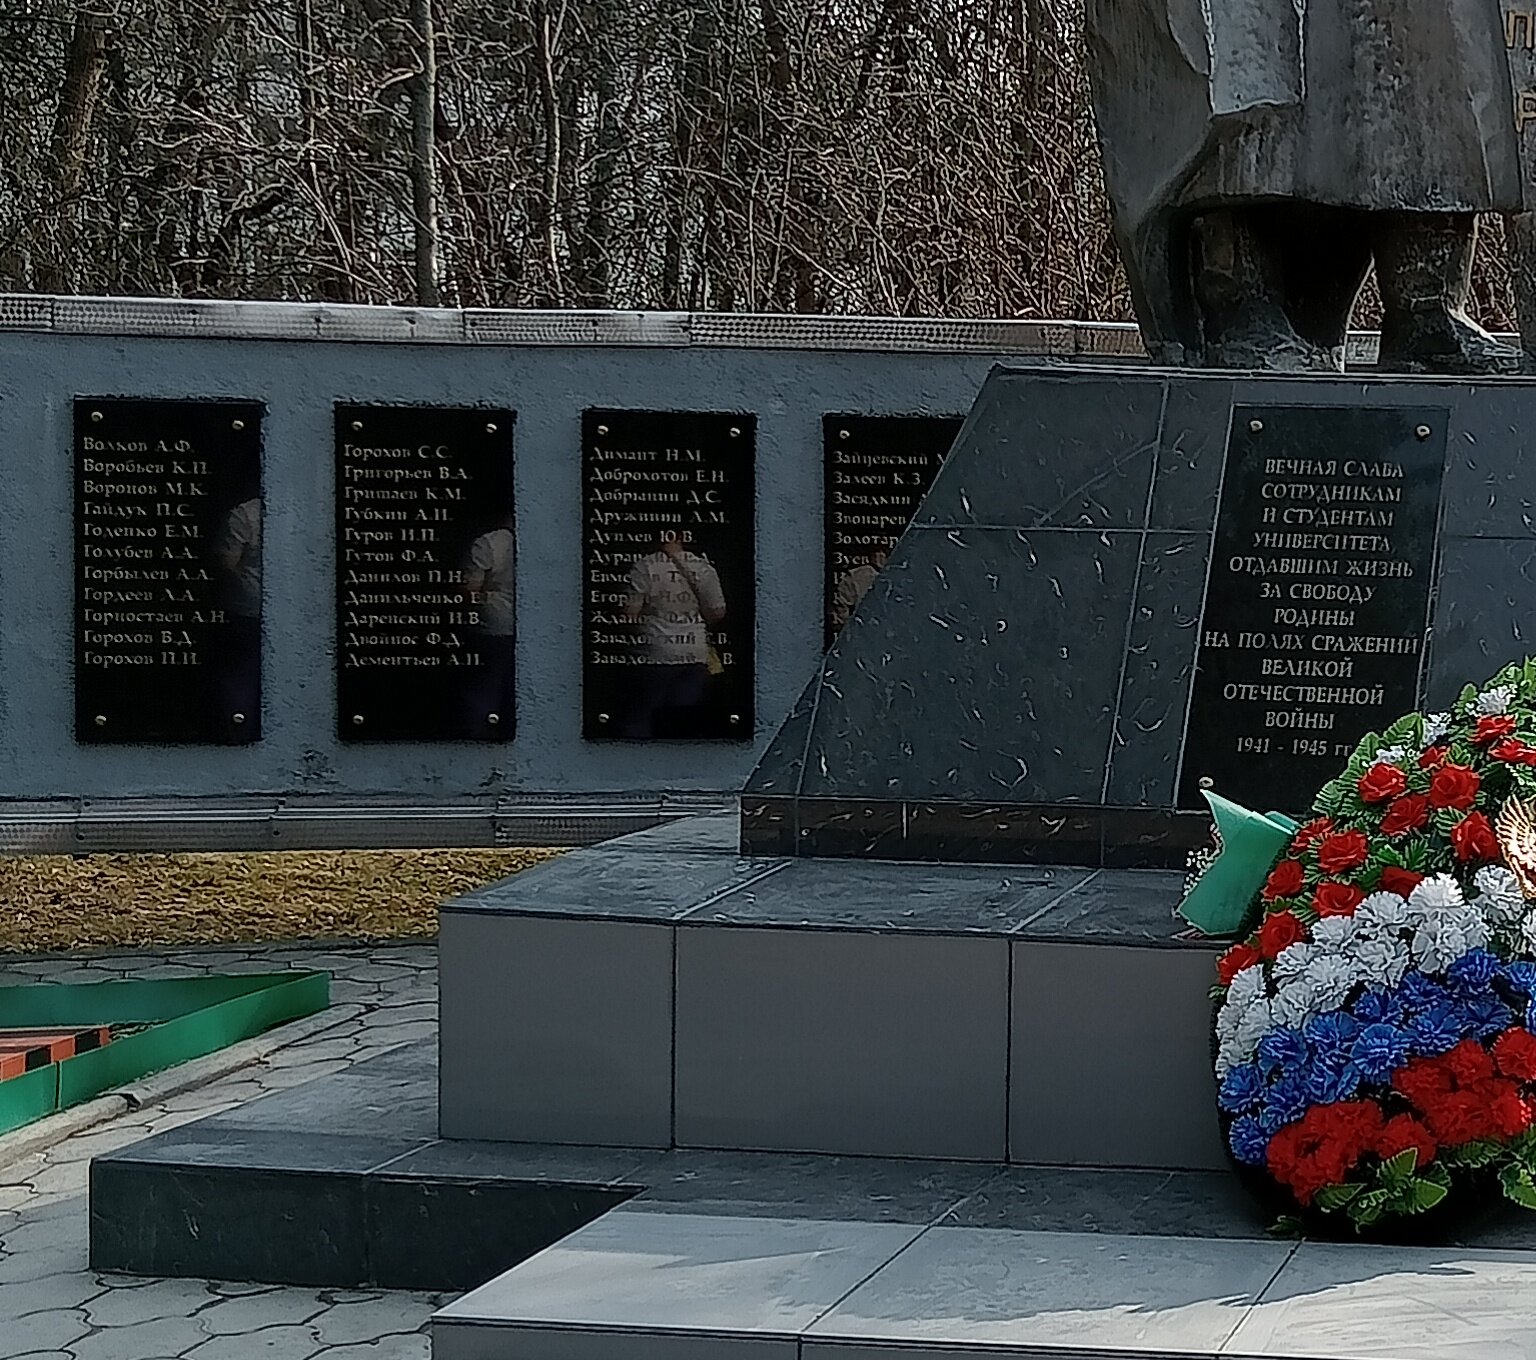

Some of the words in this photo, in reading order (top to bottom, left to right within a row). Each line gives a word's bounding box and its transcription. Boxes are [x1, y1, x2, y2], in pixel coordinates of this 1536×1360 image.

[84, 437, 147, 451] Волков
[343, 444, 411, 461] Горохов
[84, 459, 164, 476] Воробьев
[344, 466, 432, 482] Григорьев
[1265, 459, 1337, 477] ВЕЧНАЯ
[1344, 461, 1404, 478] СЛАВА
[84, 480, 157, 497] Воронов
[1261, 483, 1401, 504] СОТРУДНИКАМ
[84, 502, 147, 519] Гайдук
[1263, 507, 1276, 523] И
[1283, 508, 1394, 529] СТУДЕНТАМ
[345, 528, 393, 545] Гуров
[832, 532, 898, 548] Золотар
[1229, 557, 1338, 576] ОТДАВШИМ
[1346, 560, 1413, 578] ЖИЗНЬ
[1260, 583, 1281, 598] ЗА
[1290, 584, 1377, 603] СВОБОДУ
[84, 609, 183, 625] Горностаев
[1273, 609, 1355, 628] РОДИНЫ
[84, 630, 153, 647] Горохов
[1205, 632, 1230, 647] НА
[1239, 633, 1303, 650] ПОЛЯХ
[1311, 633, 1419, 654] СРАЖЕНИЙ
[84, 652, 154, 668] Горохов
[1262, 656, 1353, 678] ВЕЛИКОЙ
[1224, 683, 1384, 705] ОТЕЧЕСТВЕННОЙ
[1265, 709, 1335, 730] ВОЙНЫ
[1236, 738, 1271, 753] 1941
[1292, 739, 1327, 755] 1945
